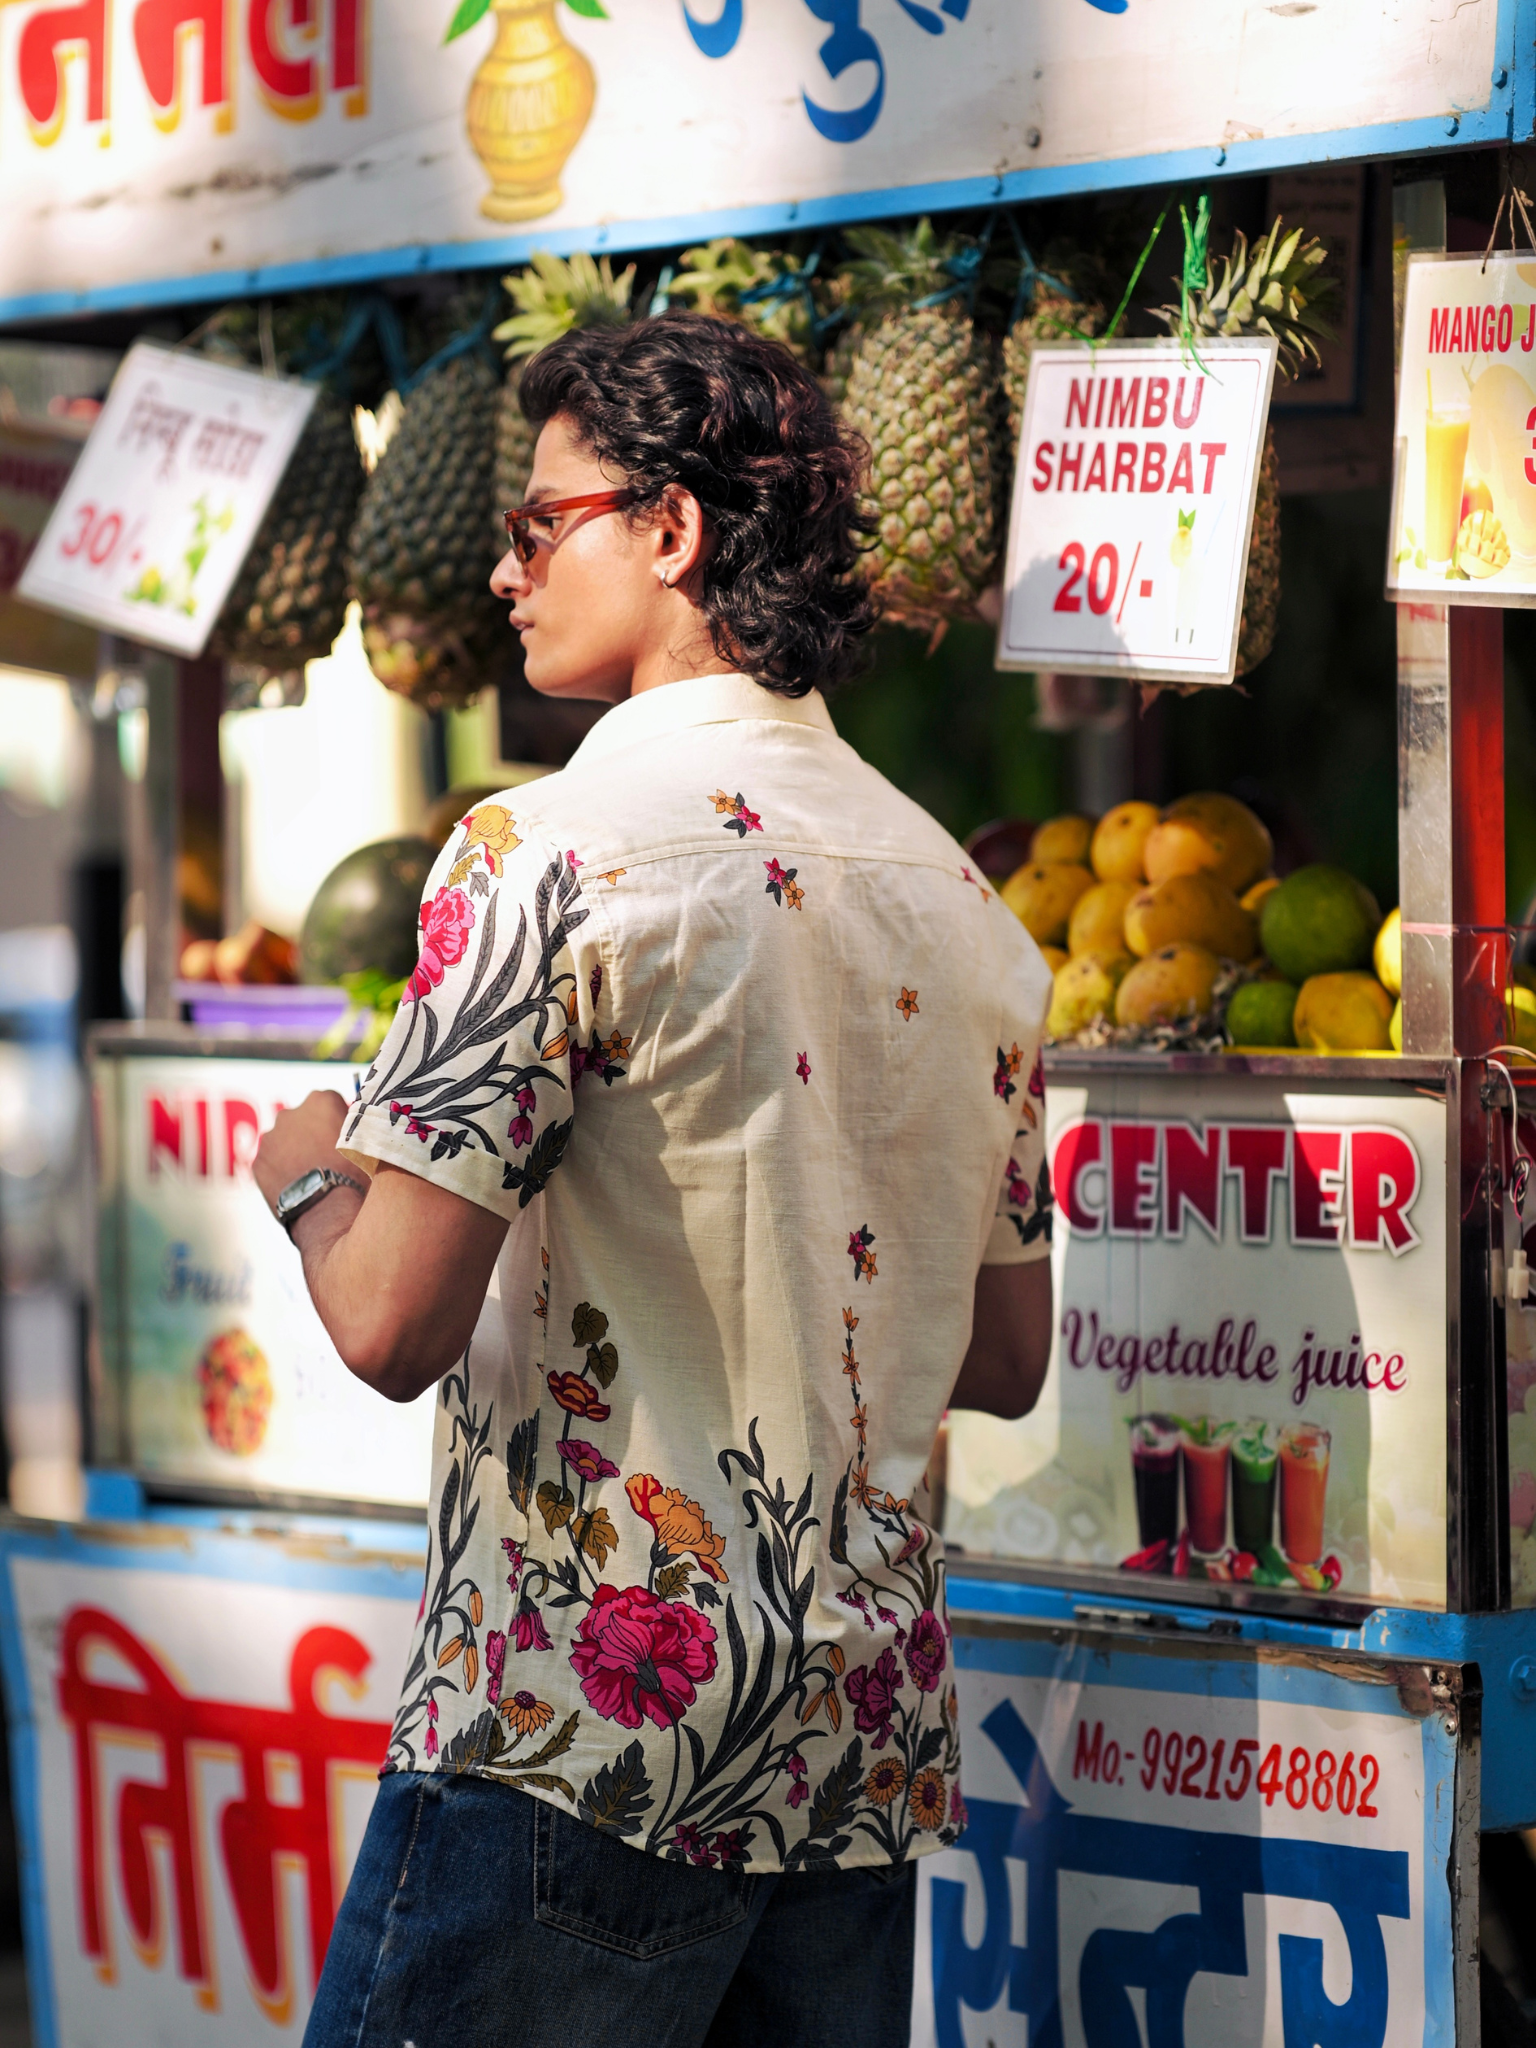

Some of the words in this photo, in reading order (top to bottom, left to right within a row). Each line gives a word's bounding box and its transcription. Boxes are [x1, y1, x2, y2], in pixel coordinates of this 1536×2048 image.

[1429, 303, 1513, 354] MANGO
[1065, 376, 1205, 430] NIMBU
[1032, 441, 1227, 494] SHARBAT
[148, 1090, 286, 1178] NIR
[1053, 1117, 1420, 1255] CENTER
[1061, 1308, 1279, 1393] Vegetable
[1293, 1327, 1407, 1406] juice
